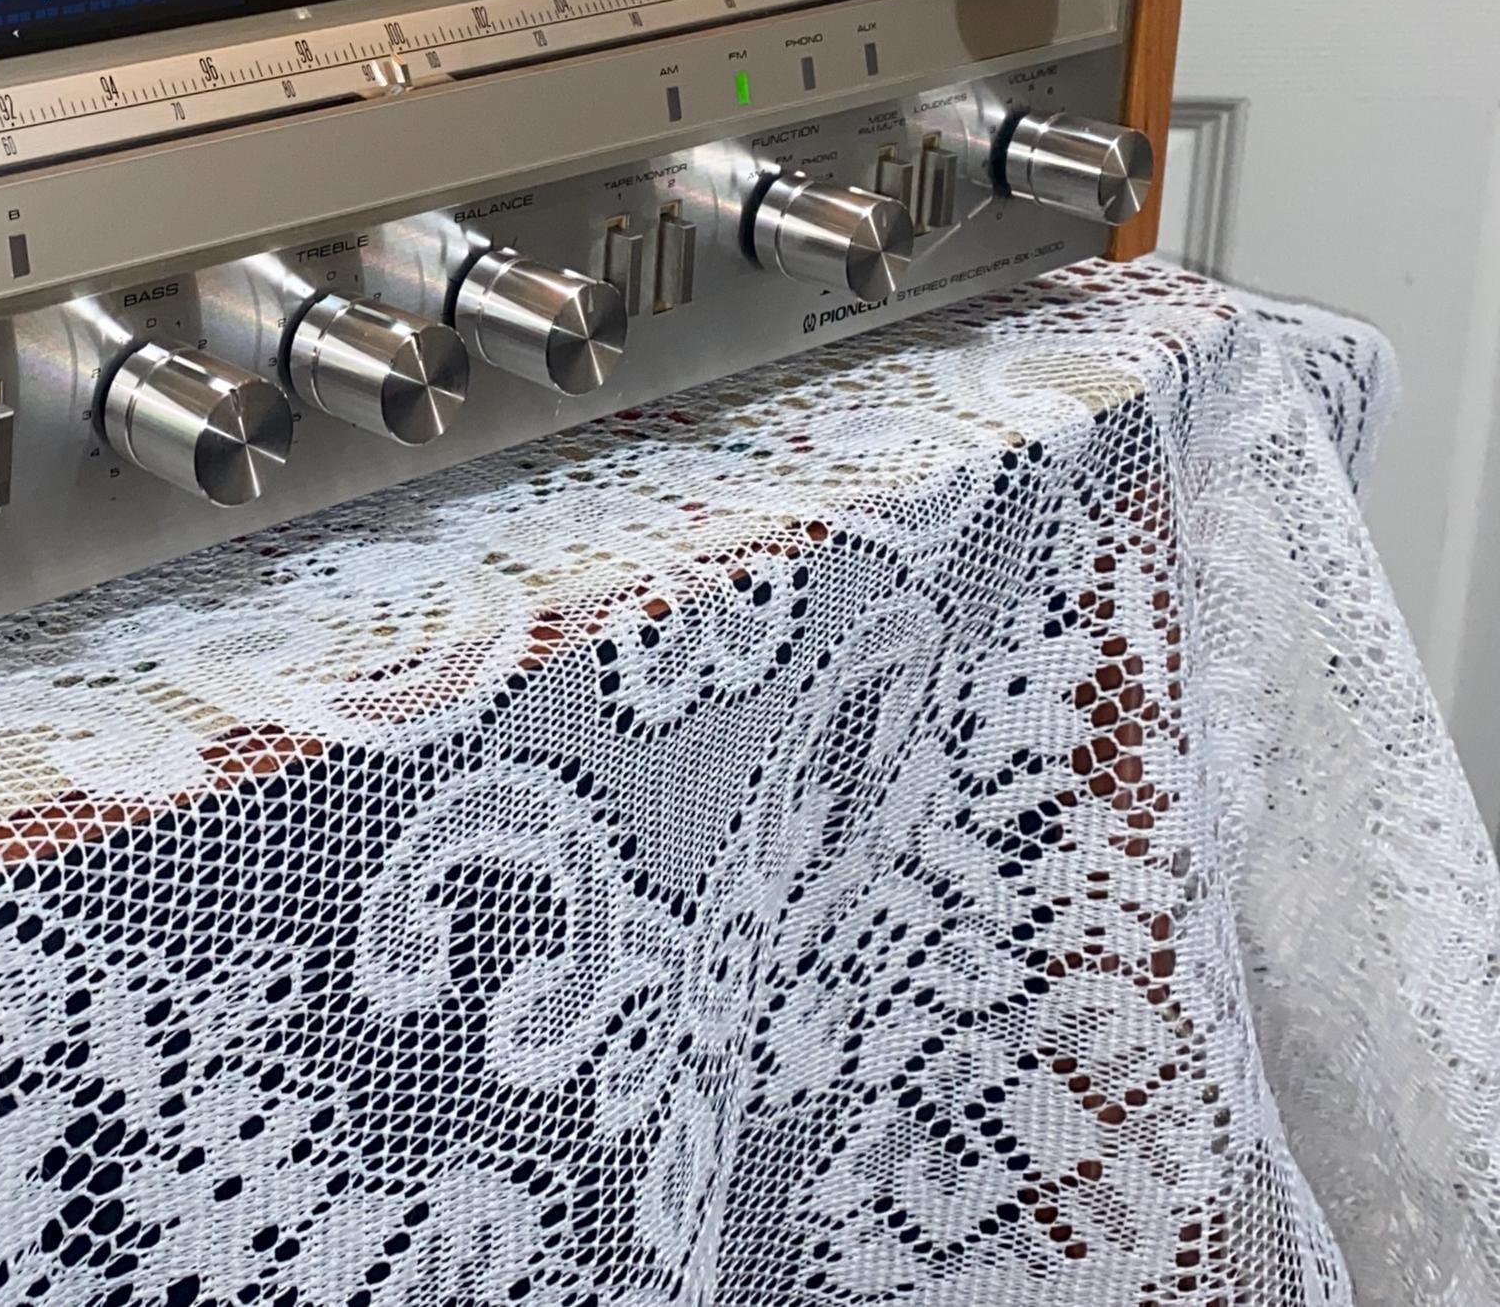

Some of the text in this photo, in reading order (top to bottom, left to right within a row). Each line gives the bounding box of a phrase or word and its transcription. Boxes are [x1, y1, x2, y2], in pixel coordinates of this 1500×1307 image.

[856, 22, 877, 33] AUX
[785, 33, 823, 48] PHONO
[0, 94, 17, 122] 92
[100, 75, 119, 102] 94
[200, 57, 219, 81] 96
[295, 40, 313, 64] 98
[384, 21, 406, 46] 100
[472, 6, 491, 28] 102
[728, 50, 748, 61] FM
[659, 65, 679, 77] AM
[0, 135, 17, 156] 60
[171, 102, 186, 122] 70
[281, 79, 296, 99] 80
[361, 64, 376, 82] 90
[751, 125, 820, 149] FUNCTION
[604, 174, 634, 191] TAPE
[8, 209, 20, 220] B
[454, 194, 534, 224] BALANCE
[296, 235, 370, 263] TREBLE
[896, 278, 947, 302] STEREO
[950, 259, 1010, 287] RECEIVER
[124, 283, 179, 307] BASS
